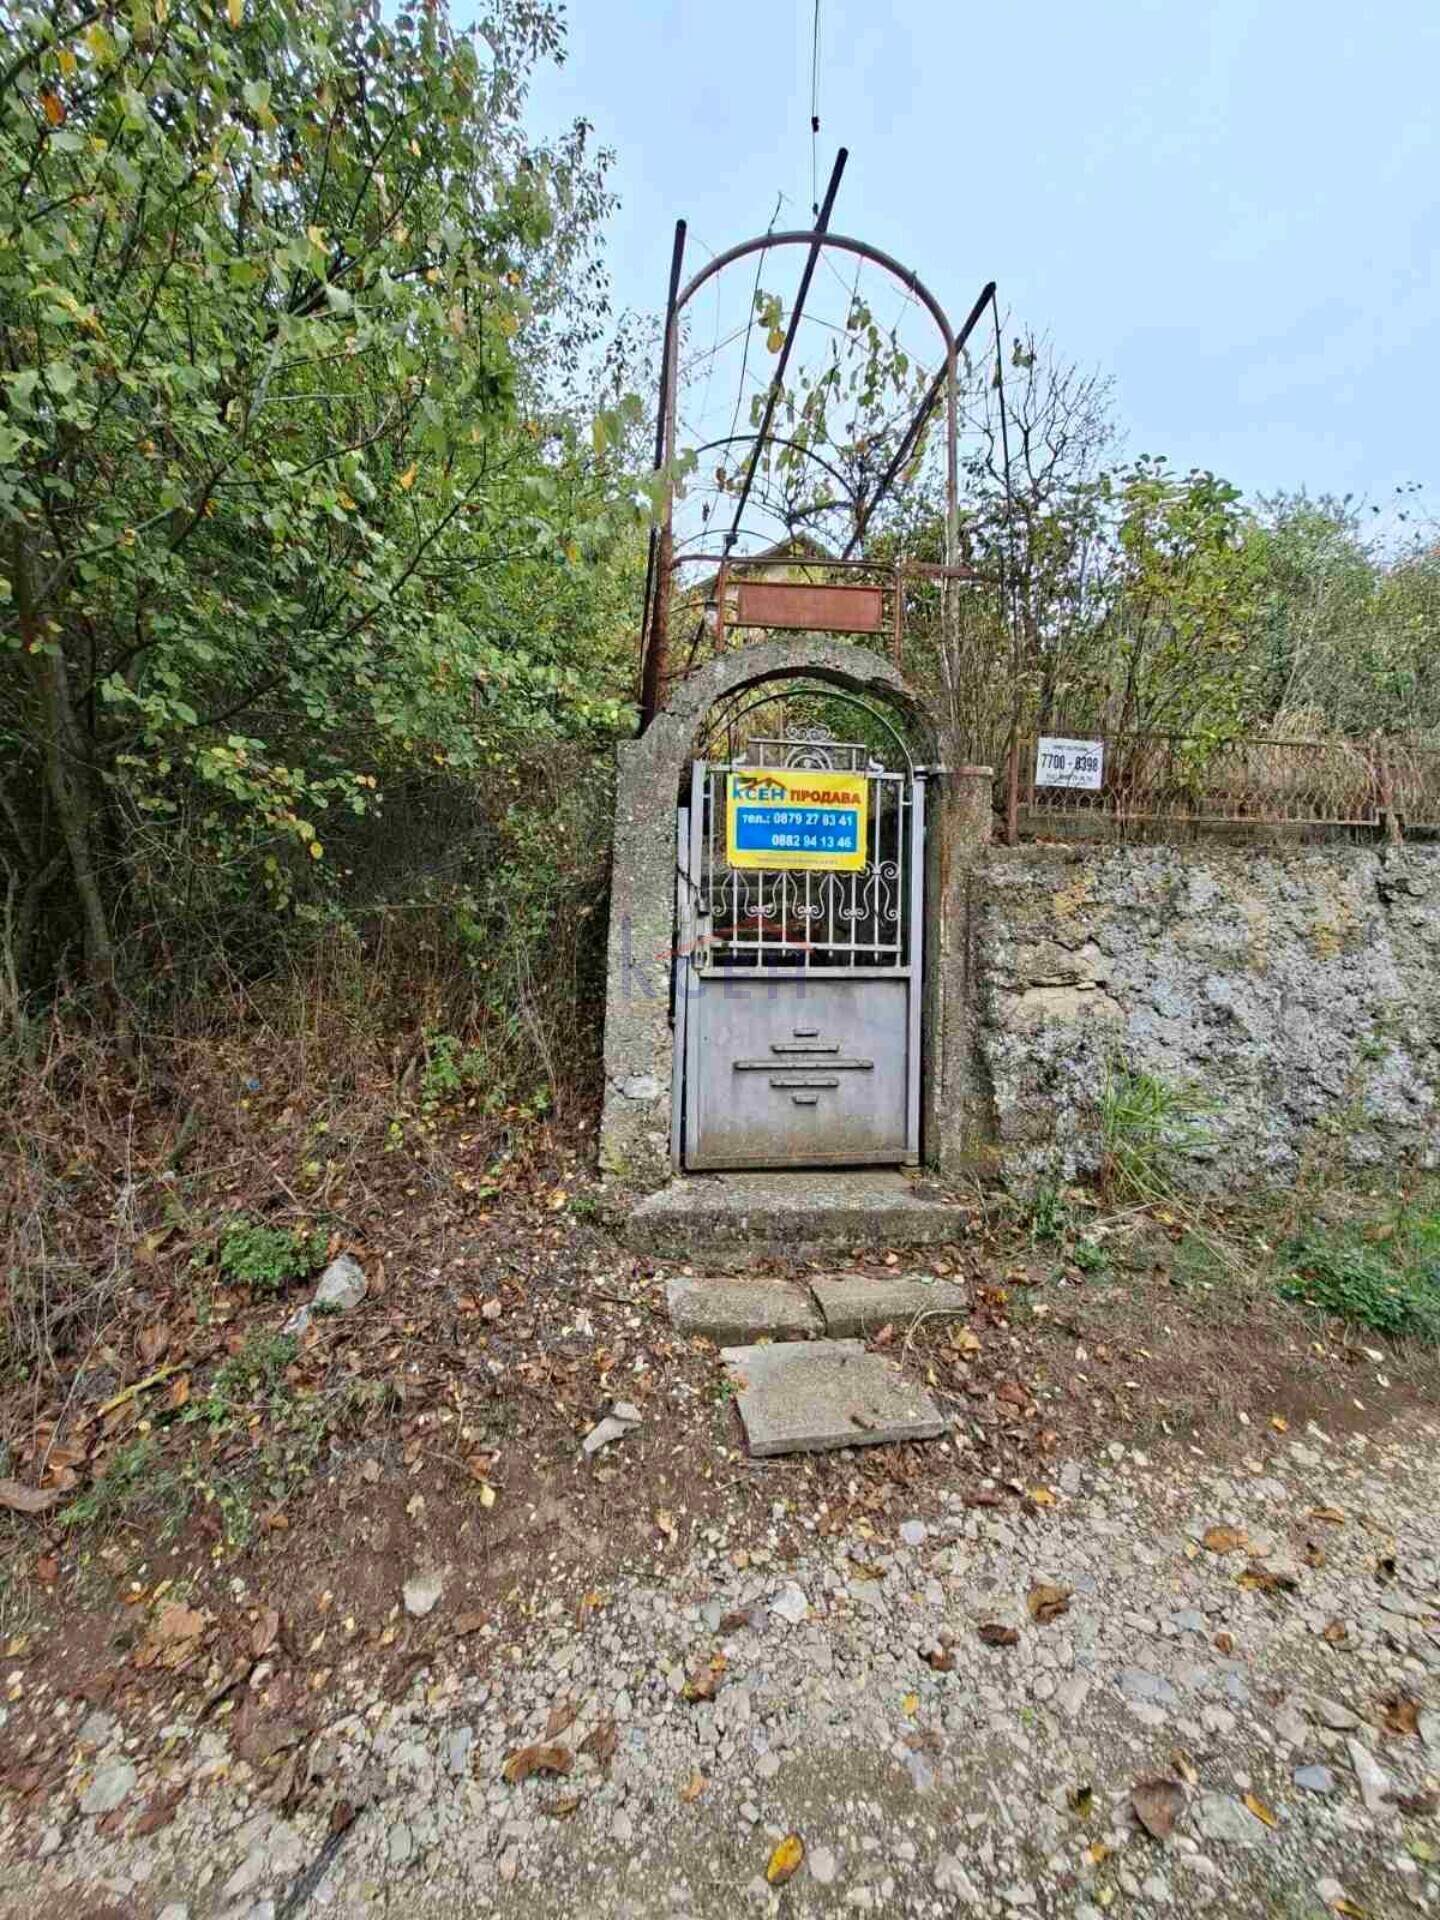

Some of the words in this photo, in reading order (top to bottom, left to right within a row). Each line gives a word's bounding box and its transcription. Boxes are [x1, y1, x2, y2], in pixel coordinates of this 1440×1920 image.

[1041, 753, 1065, 769] 7700
[732, 777, 785, 801] КСЕН
[790, 789, 861, 805] ПРОДАВА
[742, 814, 770, 825] тел.:
[773, 812, 803, 825] 0879
[805, 813, 819, 826] 27
[838, 814, 852, 827] 41
[771, 834, 800, 847] 0882
[803, 835, 817, 847] 94
[820, 836, 834, 848] 13
[837, 837, 852, 848] 46
